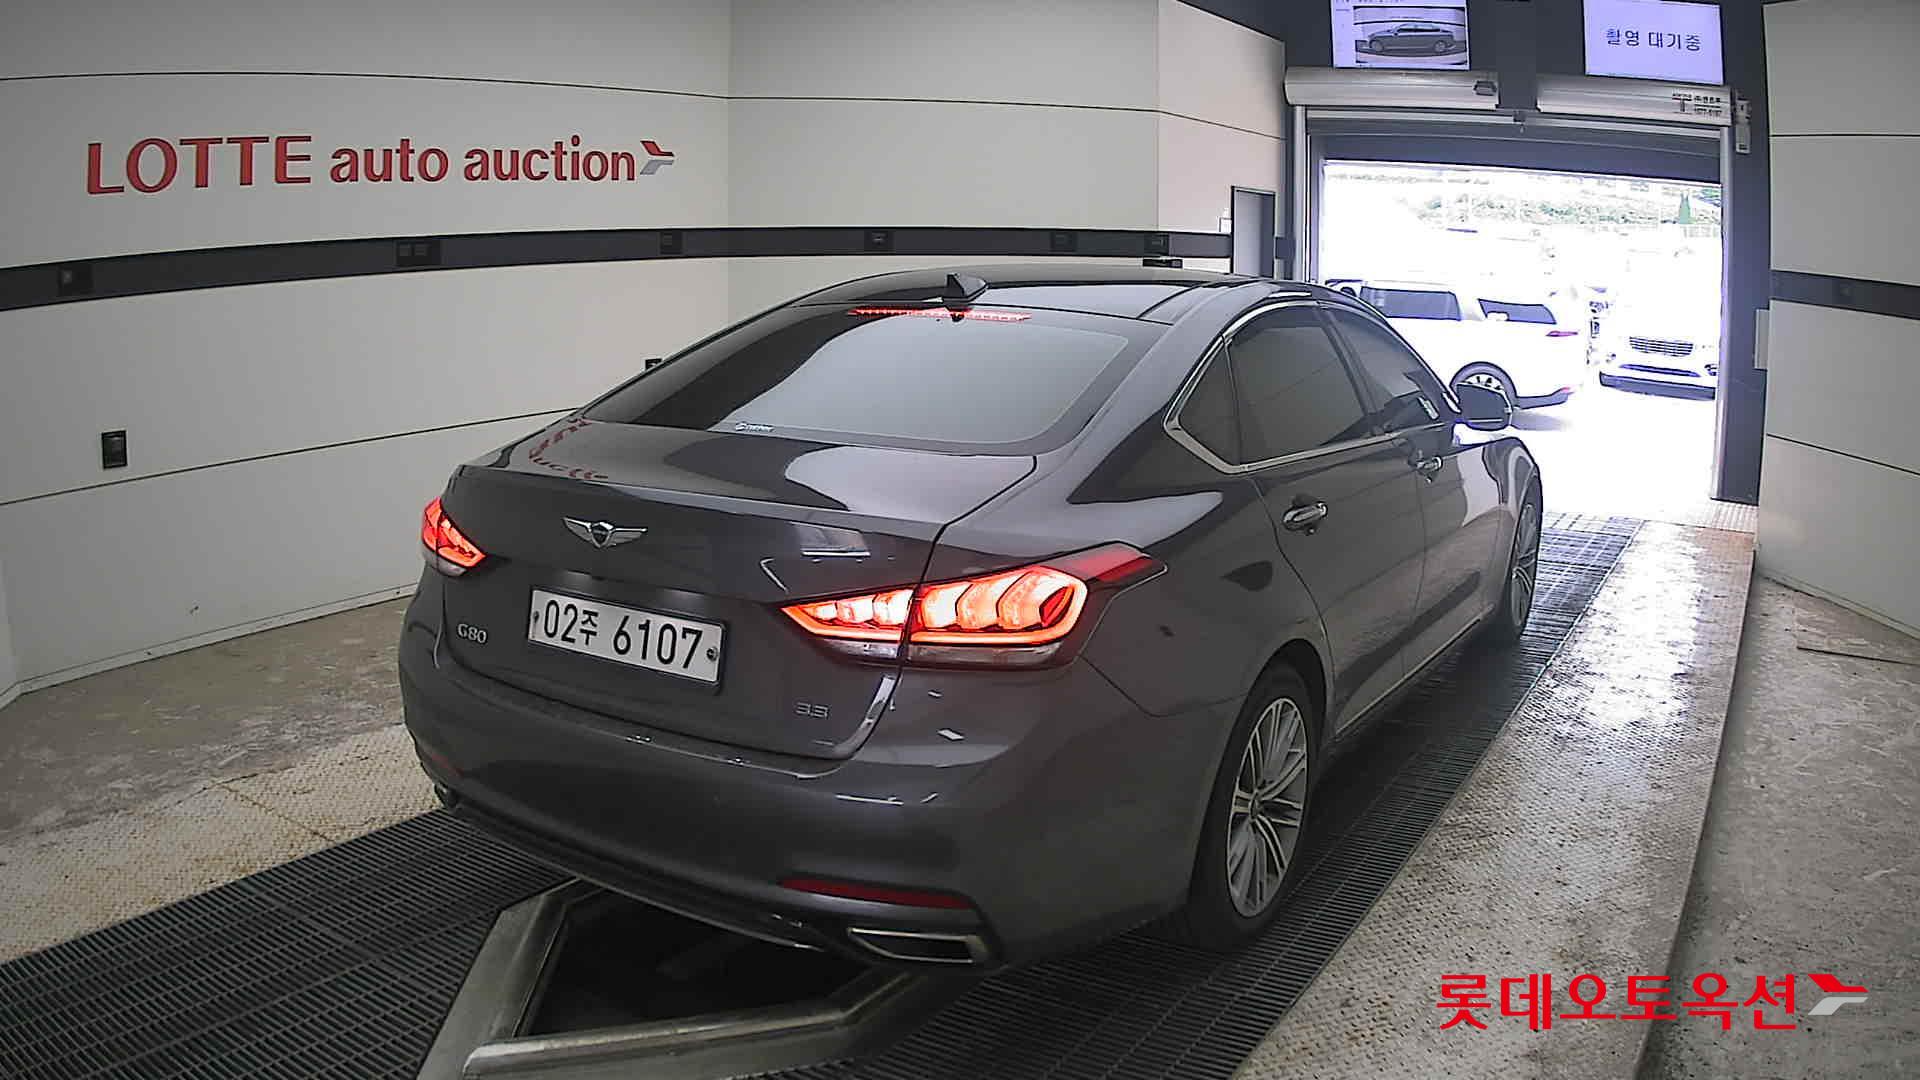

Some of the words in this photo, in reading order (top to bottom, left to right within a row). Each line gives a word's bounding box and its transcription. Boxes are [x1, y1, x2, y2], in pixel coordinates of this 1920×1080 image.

[1647, 31, 1701, 51] 대기중
[87, 135, 312, 195] LOTTE
[330, 138, 449, 183] auto
[463, 134, 636, 182] auction
[457, 623, 487, 643] G80
[543, 599, 600, 646] 02주
[613, 615, 704, 669] 6107
